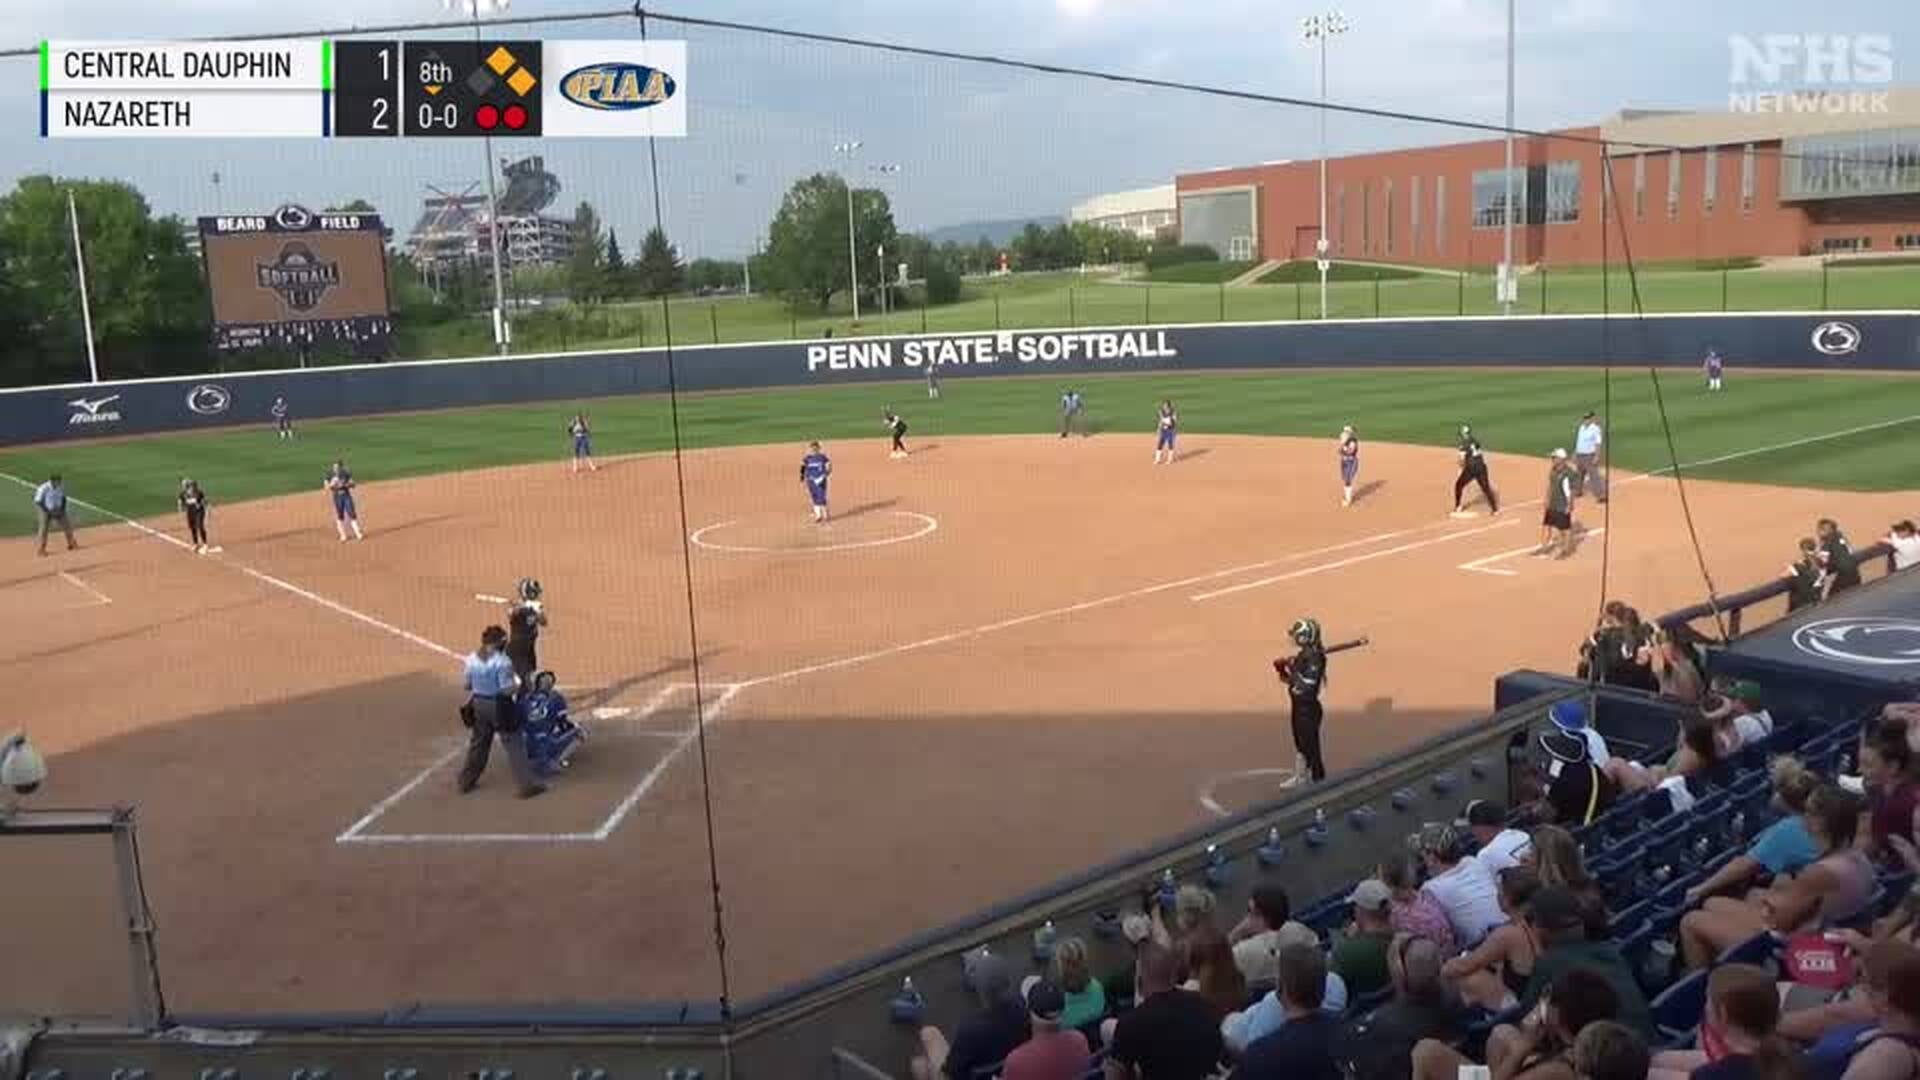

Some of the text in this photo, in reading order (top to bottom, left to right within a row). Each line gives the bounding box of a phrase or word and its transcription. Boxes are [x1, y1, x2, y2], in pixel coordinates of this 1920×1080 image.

[217, 215, 360, 232] BEARD FIELD
[260, 266, 336, 285] SOFTBALL
[807, 341, 892, 371] PENN
[1017, 330, 1176, 362] SOFTBALL
